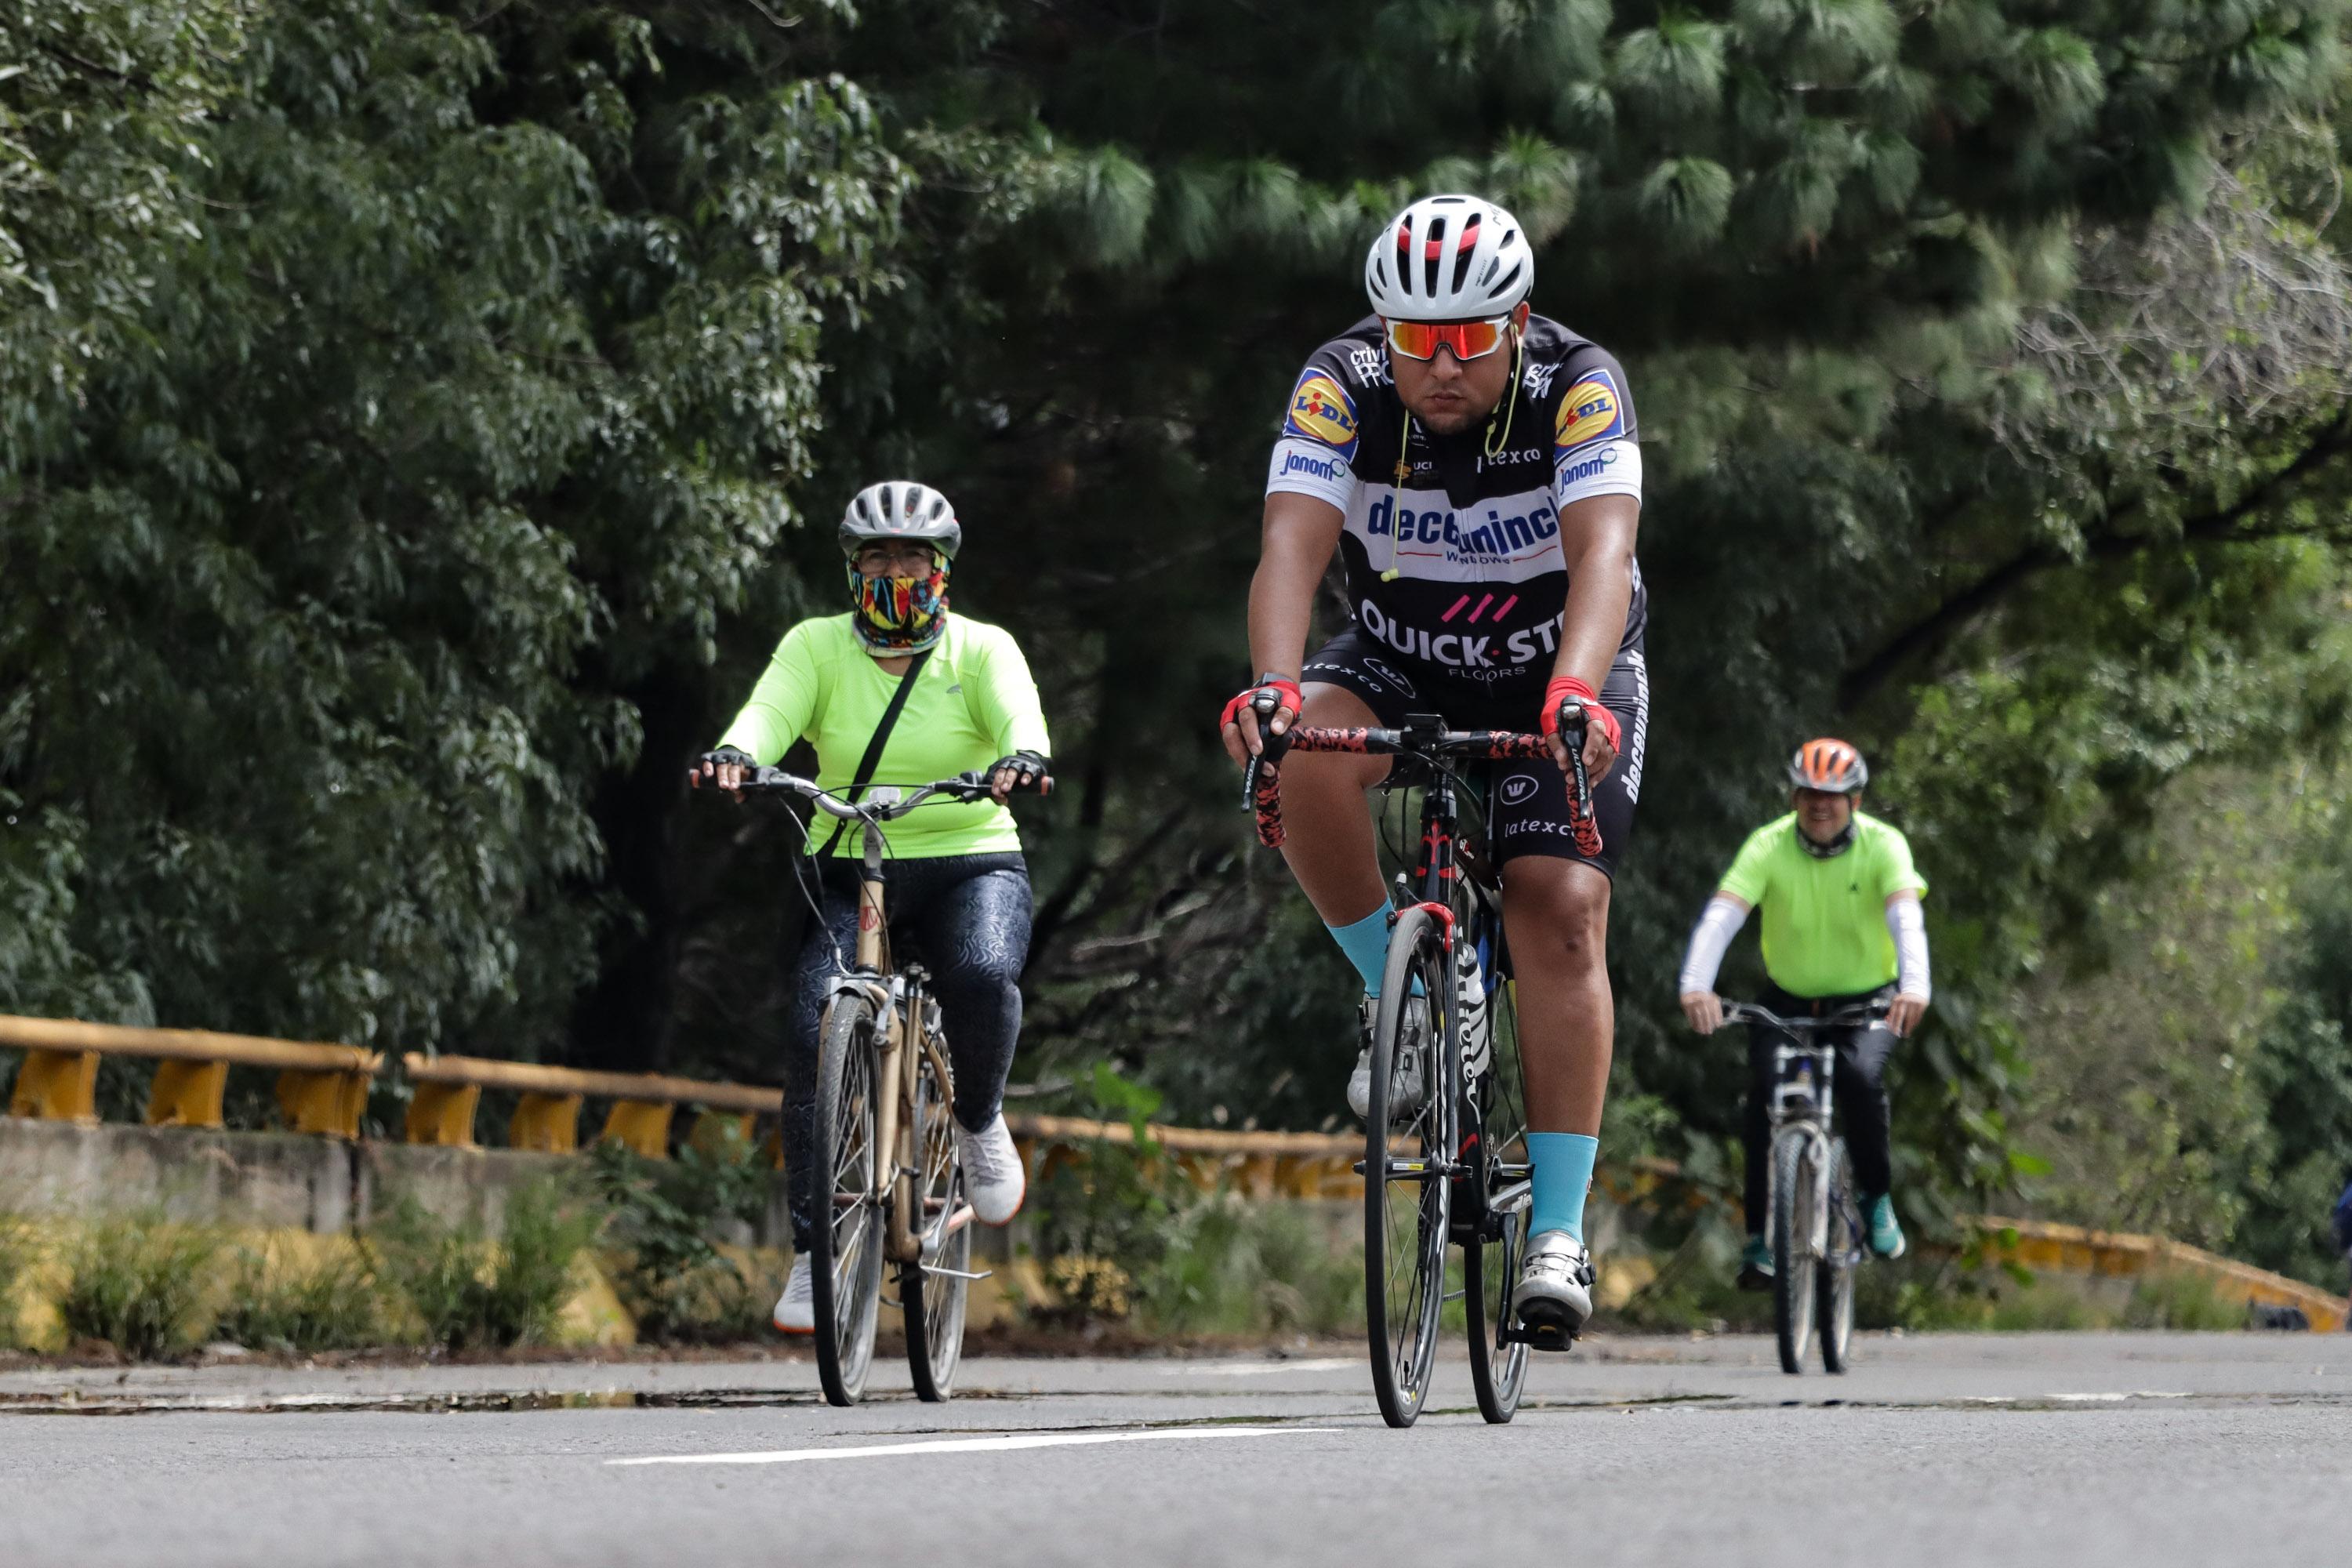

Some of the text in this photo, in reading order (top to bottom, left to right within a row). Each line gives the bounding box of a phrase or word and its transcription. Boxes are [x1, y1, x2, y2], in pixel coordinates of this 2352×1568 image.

[1414, 461, 1433, 470] UCI
[1476, 448, 1541, 474] ltexco
[1449, 666, 1526, 682] FLOORS
[1572, 748, 1586, 800] ULTEGRA
[1504, 818, 1575, 838] latexc
